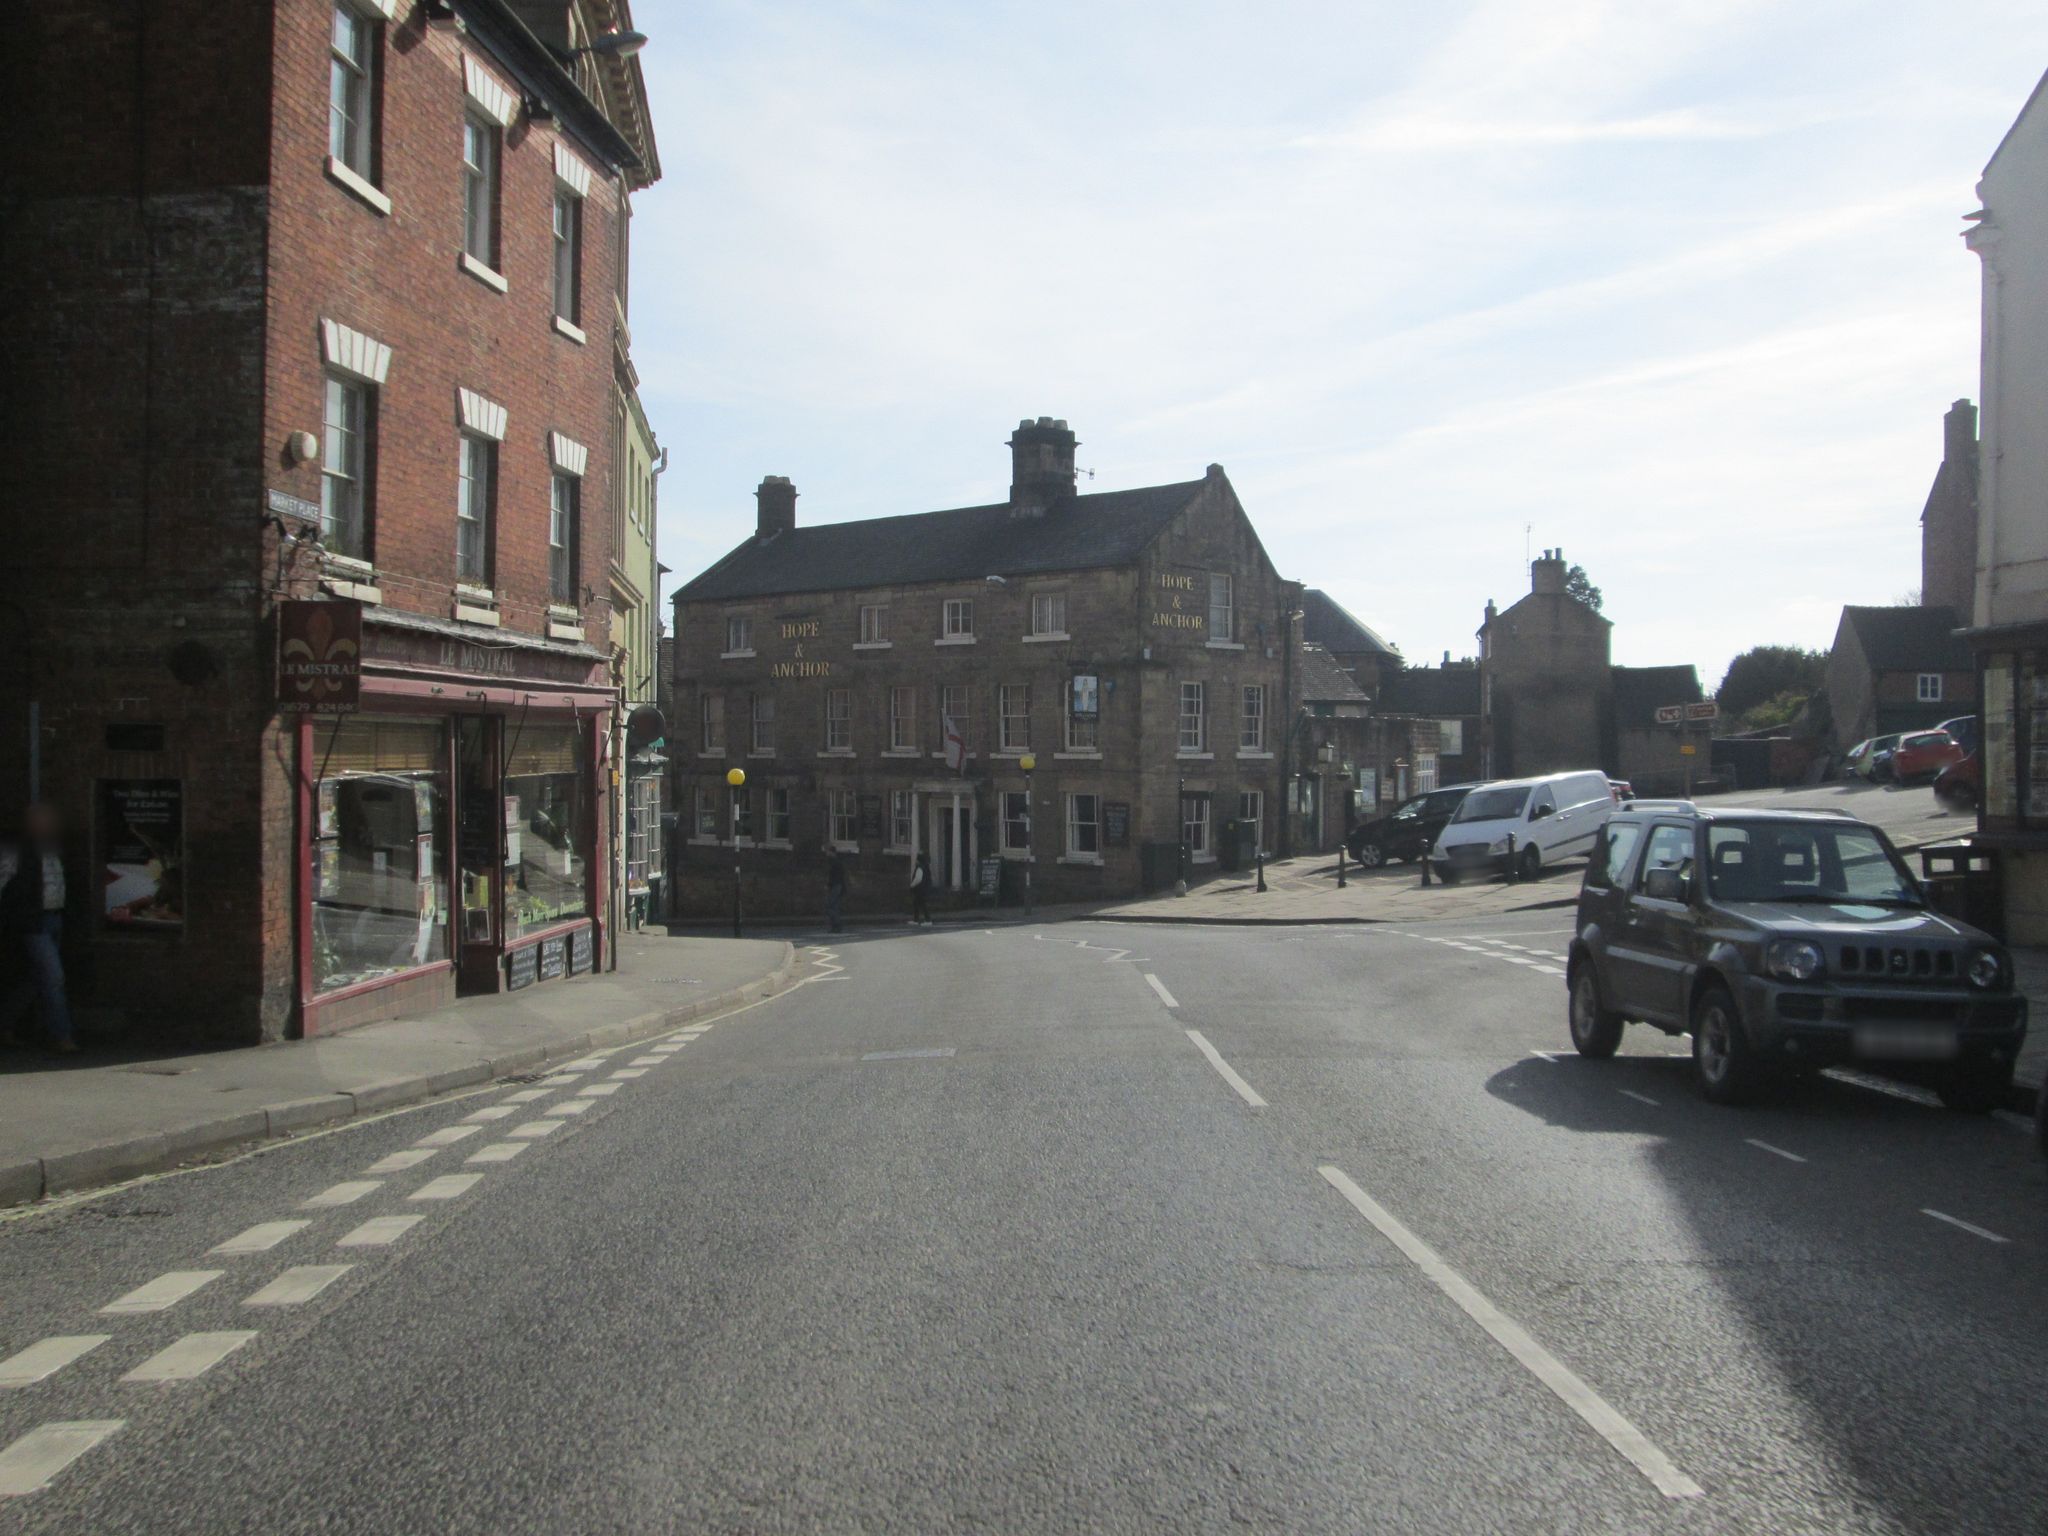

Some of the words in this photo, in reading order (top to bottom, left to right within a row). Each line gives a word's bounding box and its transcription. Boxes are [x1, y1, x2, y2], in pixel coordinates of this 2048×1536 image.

[271, 493, 298, 512] MARKET
[299, 503, 319, 519] PLACE
[1162, 574, 1194, 591] HOPE
[1172, 594, 1183, 610] &
[1152, 613, 1203, 629] ANCHOR
[782, 622, 820, 639] HOPE
[439, 642, 456, 667] LE
[794, 642, 804, 658] &
[280, 663, 295, 675] LE
[297, 663, 360, 675] MISTRAL
[770, 662, 831, 678] ANCHOR
